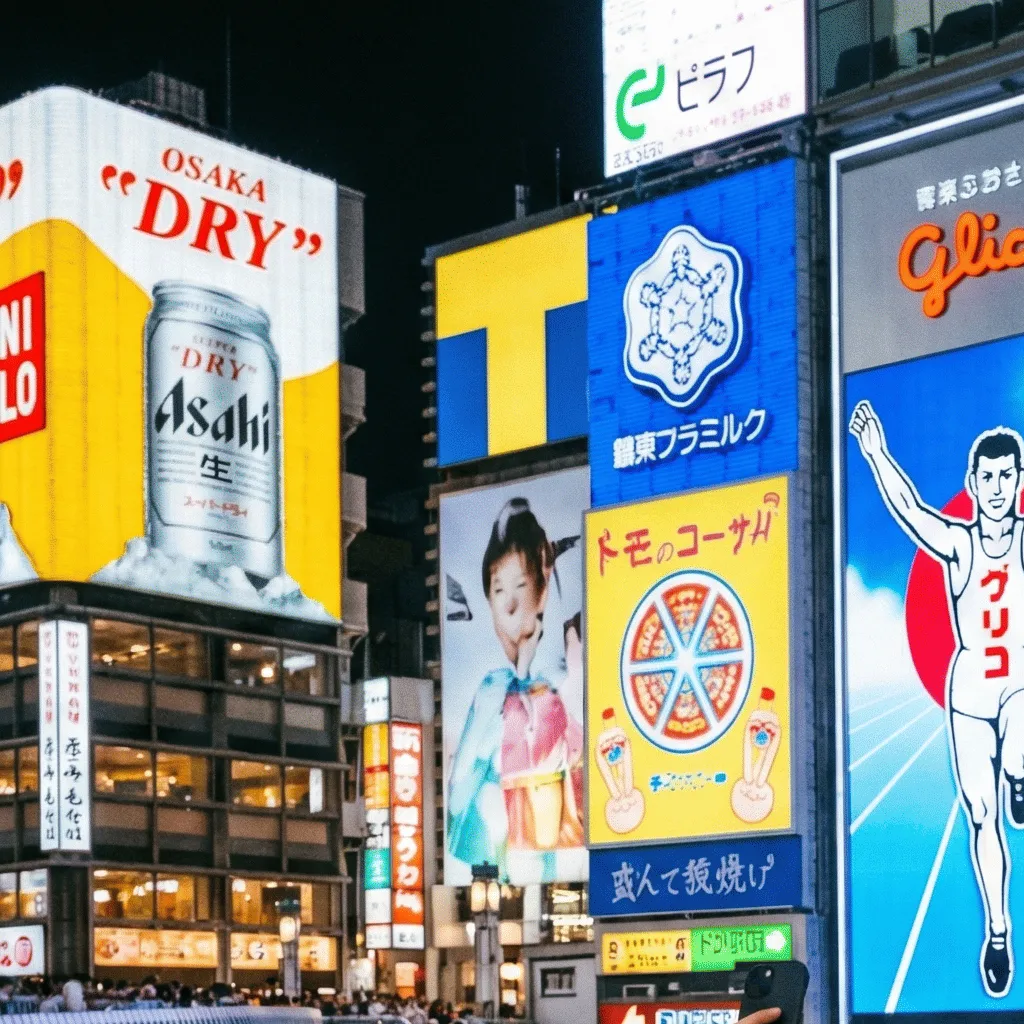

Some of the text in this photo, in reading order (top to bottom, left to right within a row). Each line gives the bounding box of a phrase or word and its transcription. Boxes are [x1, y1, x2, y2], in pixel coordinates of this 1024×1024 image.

[677, 45, 755, 113] ピラフ
[161, 147, 267, 203] OSAKA
[154, 376, 270, 455] Asahi
[200, 453, 233, 484] 生
[979, 564, 1011, 679] グリコ
